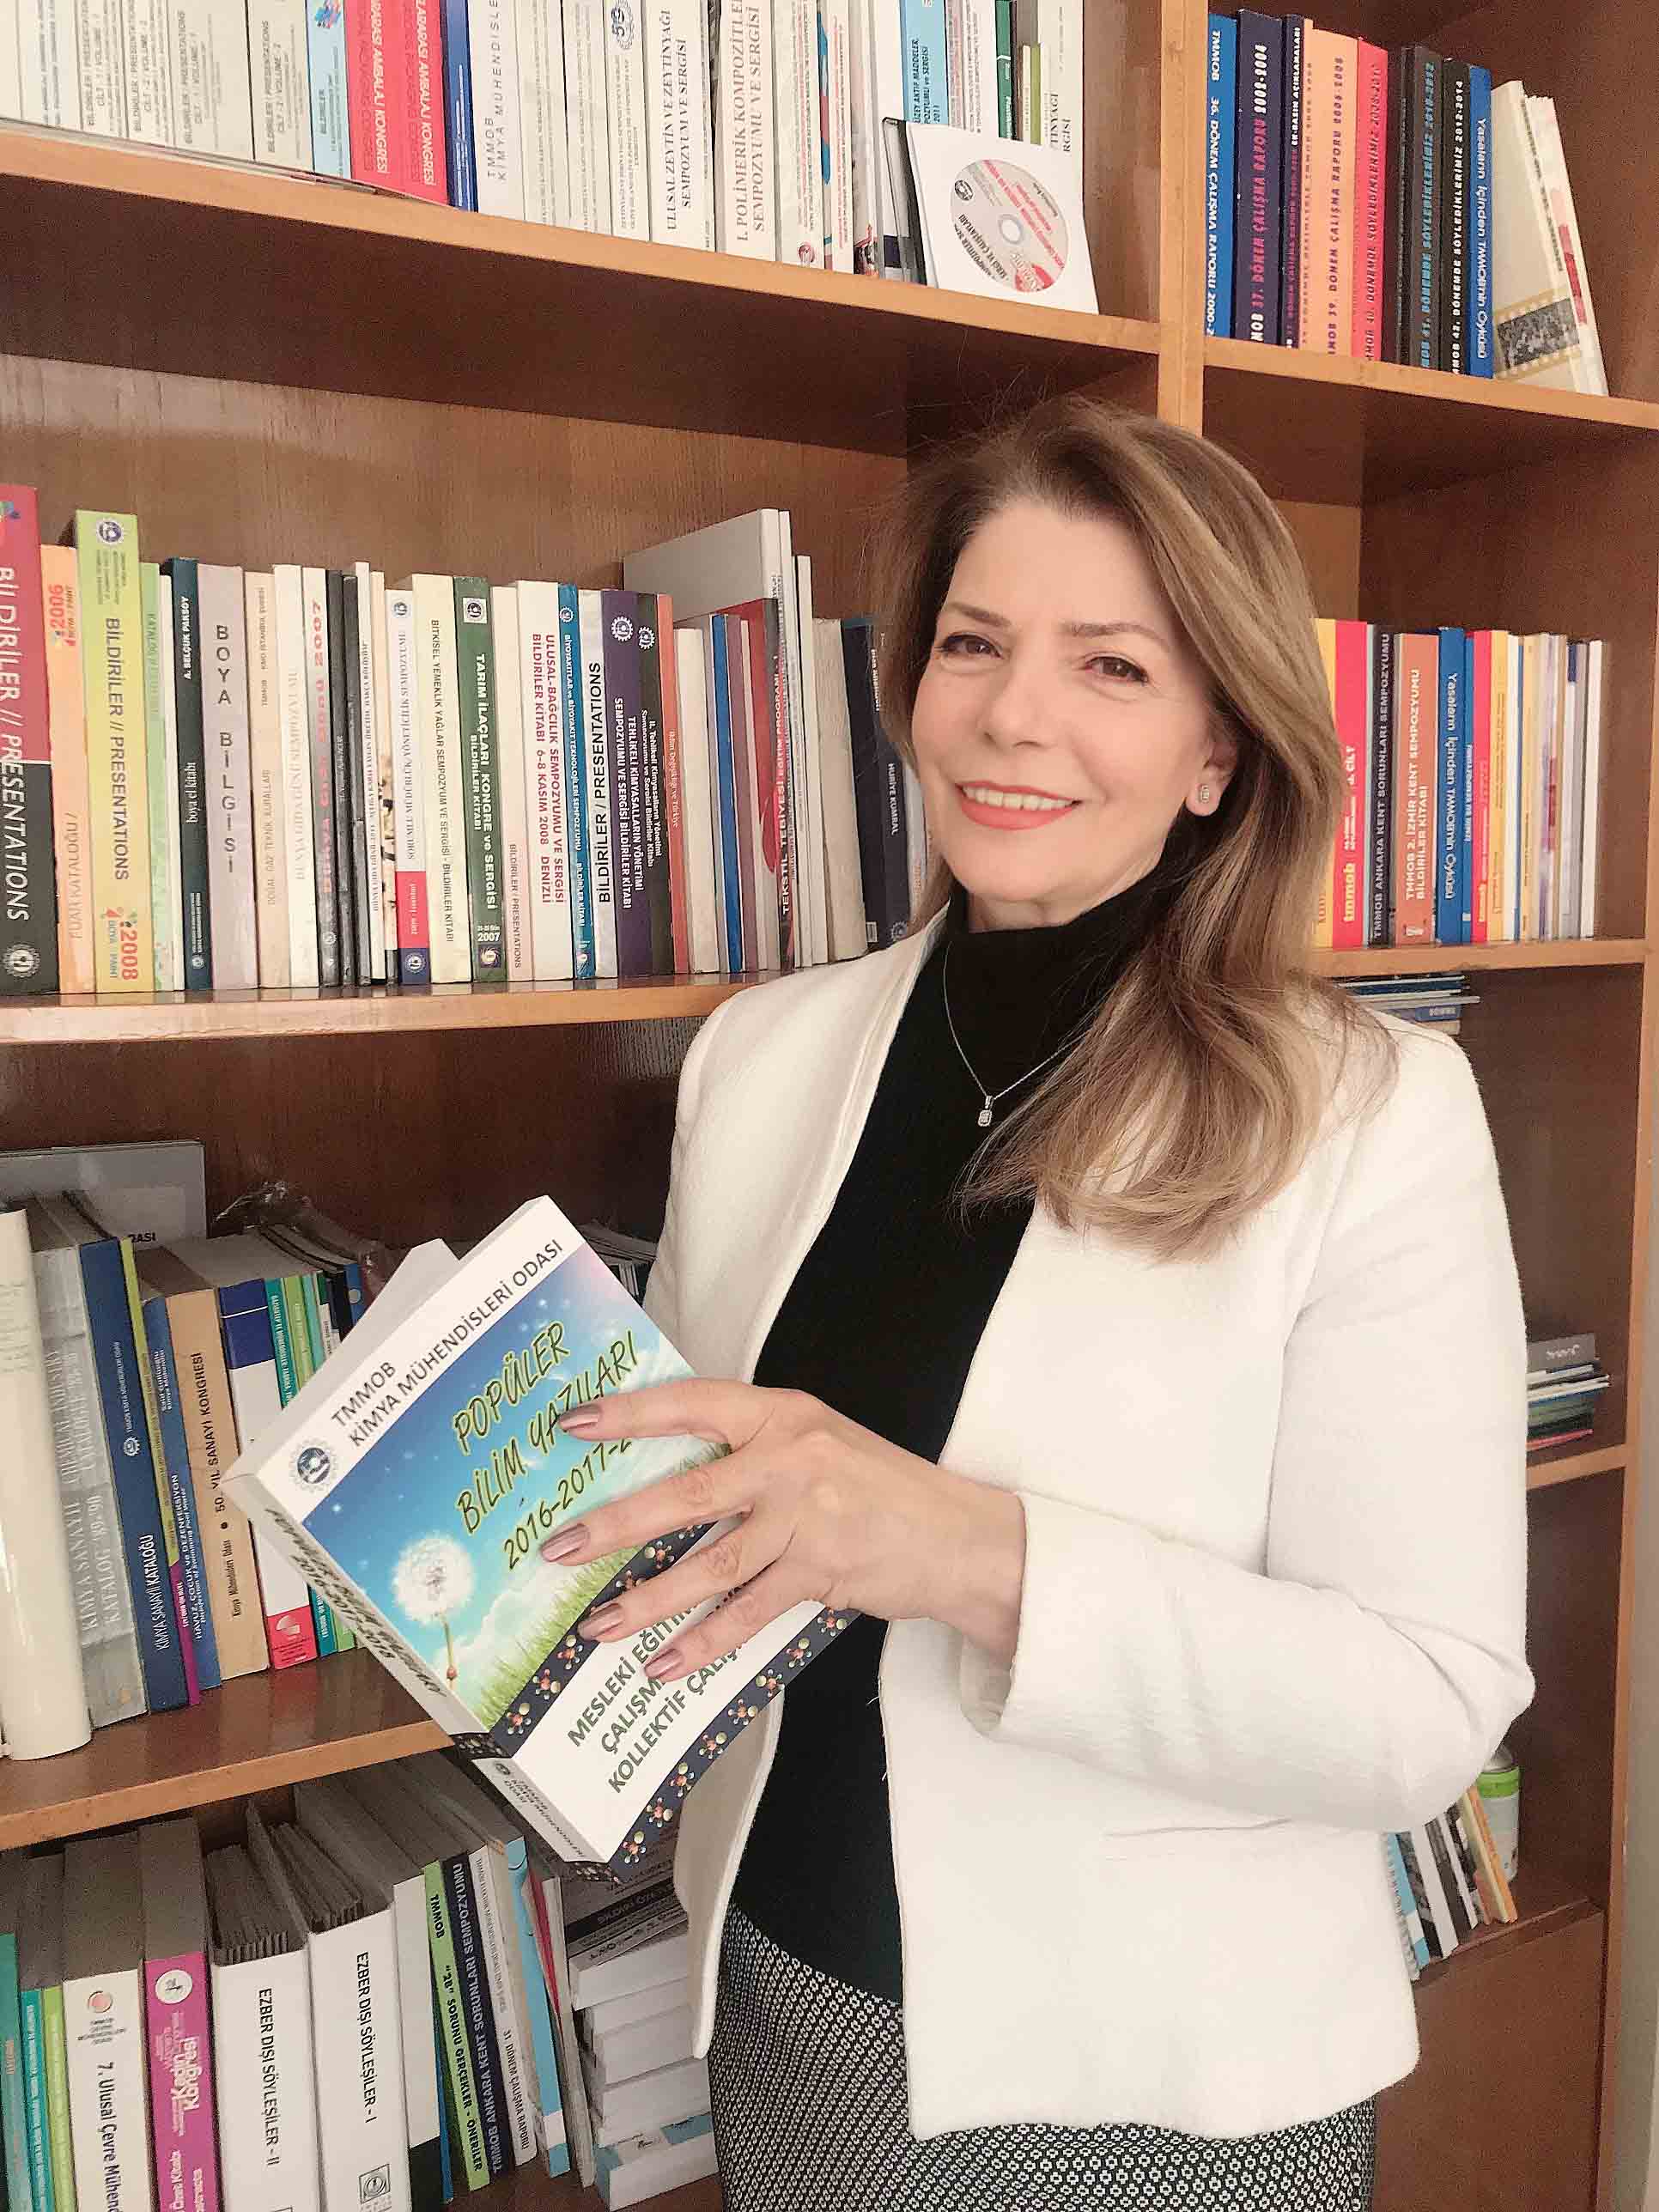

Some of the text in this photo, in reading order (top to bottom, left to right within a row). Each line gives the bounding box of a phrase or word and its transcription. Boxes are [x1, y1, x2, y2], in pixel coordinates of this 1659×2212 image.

[484, 118, 496, 178] TMMOB
[659, 9, 677, 229] ULUSAL ZEYTİN VE ZEYTİNYAĞI
[675, 39, 691, 208] SEMPOZYUM VE SERGİSİ
[745, 5, 765, 232] SEMPOZYUMU VE SERGİSİ
[1207, 30, 1221, 289] TMMOB 36. DÖNEM ÇALIŞMA RAPORU
[732, 129, 749, 227] POLİMERİK
[1249, 118, 1268, 308] 37. DÖNEM ÇALIŞMA RAPORU
[1327, 131, 1341, 292] DÖNEM RAPORU
[1453, 146, 1463, 254] SÖYLEDİKLERİMİZ
[1450, 259, 1462, 316] DÖNEMDE
[1474, 117, 1489, 359] Yasaların İçinden Öyküsü
[48, 584, 65, 629] 2006
[180, 596, 192, 668] SELÇUK PAKSOY
[105, 618, 125, 716] BİLDİRİLER
[216, 625, 232, 704] BOYA
[773, 673, 781, 735] PROGRAMI
[1446, 672, 1458, 730] Yasaların
[0, 567, 31, 921] BİLDİRİLER PRESENTATIONS
[184, 762, 201, 823] boya kitabı
[469, 735, 483, 830] BİLDİRİLER KİTABI
[474, 653, 496, 910] TARIM İLAÇLARI KONGRE ve SERGİSİ
[532, 634, 553, 903] BİLDİRİLER KİTABI 6-8 KASIM 2008 DENİZLİ
[545, 634, 567, 903] ULUSAL-BAĞCILIK SEMPOZYUMU VE SERGİSİ
[563, 634, 586, 927] BİYOYAKITLAR BİYOYAKIT TEKNOLOJİLERİ SEMPOZYUMU BİLDİRİLER KİTABI
[587, 663, 611, 902] BİLDİRİLER PRESENTATIONS
[1373, 634, 1389, 939] TMMOB ANKARA KENT SORUNLARI SEMPOZYUMU
[1405, 669, 1419, 900] TMMOB 2. İZMİR KENT SEMPOZYUMU
[1444, 737, 1460, 785] İçinden
[110, 737, 129, 880] PRESENTATIONS
[433, 662, 455, 942] YEMEKLİK YAĞLAR SEMPOZYUM VE SERGİSİ BİLDİRİLER KİTABI
[615, 697, 633, 908] SEMPOZYUMU VE SERGİSİ BİLDİRİLER KİTABI
[628, 716, 644, 891] TEHLİKELİ KİMYASALLARIN YÖNETİMİ
[645, 807, 655, 867] Bildiriler Kitabı
[650, 766, 663, 857] Kimyasalların Yönetimi
[670, 800, 680, 828] Türkiye
[890, 797, 900, 836] KUMRAL
[1417, 786, 1427, 899] BİLDİRİLER KİTABI
[477, 933, 500, 943] 2007
[508, 843, 522, 969] BİLDİRİLER PRESENTATIONS
[781, 853, 790, 915] TEKSTİL
[1343, 862, 1355, 922] tmmob
[118, 929, 138, 981] 2008
[331, 1361, 397, 1428] TMMOB
[348, 1239, 563, 1448] KİMYA MÜHENDİSLERİ ODASI
[454, 1322, 569, 1453] POPÜLER
[191, 1352, 218, 1465] SANAYİ KONGRESİ
[458, 1331, 637, 1533] BİLİM YAZILARI
[95, 1548, 124, 1624] KATALOG
[137, 1534, 171, 1650] KİMYA KATALOĞU
[170, 1474, 203, 1639] HAVUZ, ÇOCUK DEZENFEKSİYON
[187, 1530, 199, 1569] Swimming
[222, 1540, 233, 1556] Odası
[568, 1656, 635, 1747] MESLEKİ
[608, 1690, 687, 1793] KOLLEKTİF
[182, 2037, 203, 2111] Kongresi
[258, 1987, 281, 2147] EZBER DIŞI SÖYLEŞİLER
[356, 1951, 378, 2106] EZBER DIŞI SÖYLEŞİLER
[431, 1894, 483, 2171] TMMOB SORUNU GERÇEKLER ÖNERİLER
[453, 1863, 503, 2174] TMMOB ANKARA KENT SORUNLARI SEMPOZYUMU
[97, 2061, 120, 2162] 7. Ulusal Çevre
[505, 2044, 529, 2150] DÖNEM ÇALIŞMA RAPORU
